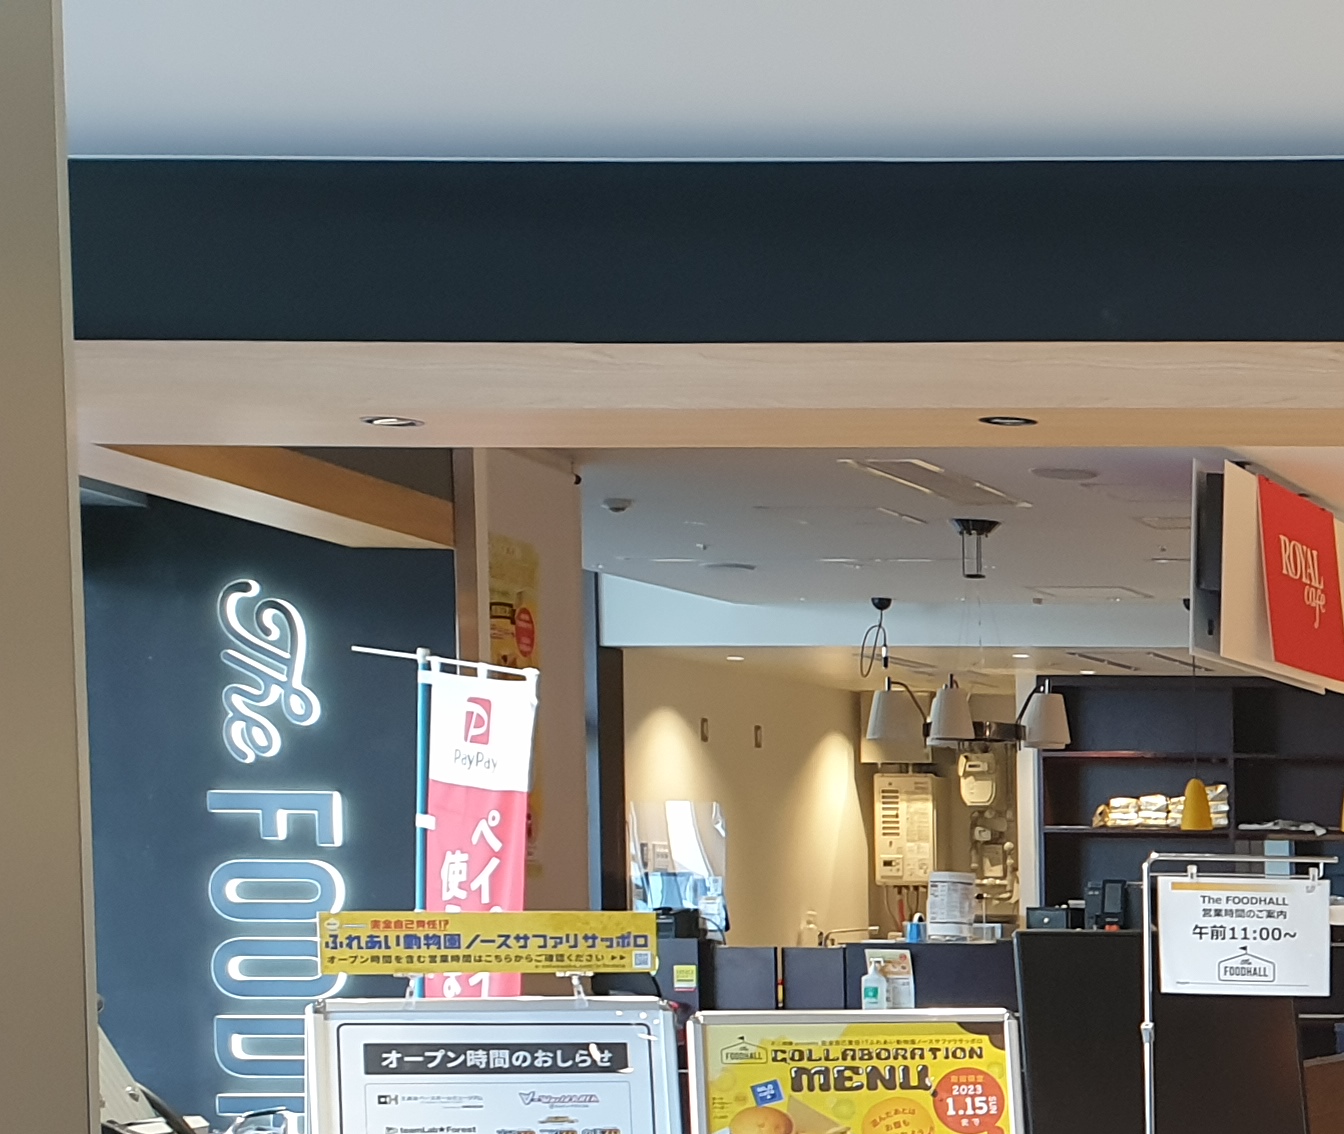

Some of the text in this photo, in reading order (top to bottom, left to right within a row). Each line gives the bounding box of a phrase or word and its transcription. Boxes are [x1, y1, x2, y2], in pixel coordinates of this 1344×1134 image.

[1278, 534, 1324, 590] ROYAL
[218, 578, 321, 764] The
[453, 748, 498, 773] PayPay
[1200, 895, 1289, 906] The FOODHALL
[1201, 908, 1288, 920] 営業時間のご案内
[1223, 966, 1269, 978] FOODHALL
[381, 1048, 613, 1070] オープン時間のおしらせ
[770, 1046, 984, 1064] COLLABORATION
[789, 1064, 934, 1093] MENU
[952, 1084, 983, 1096] 2023
[945, 1096, 988, 1116] 1.15
